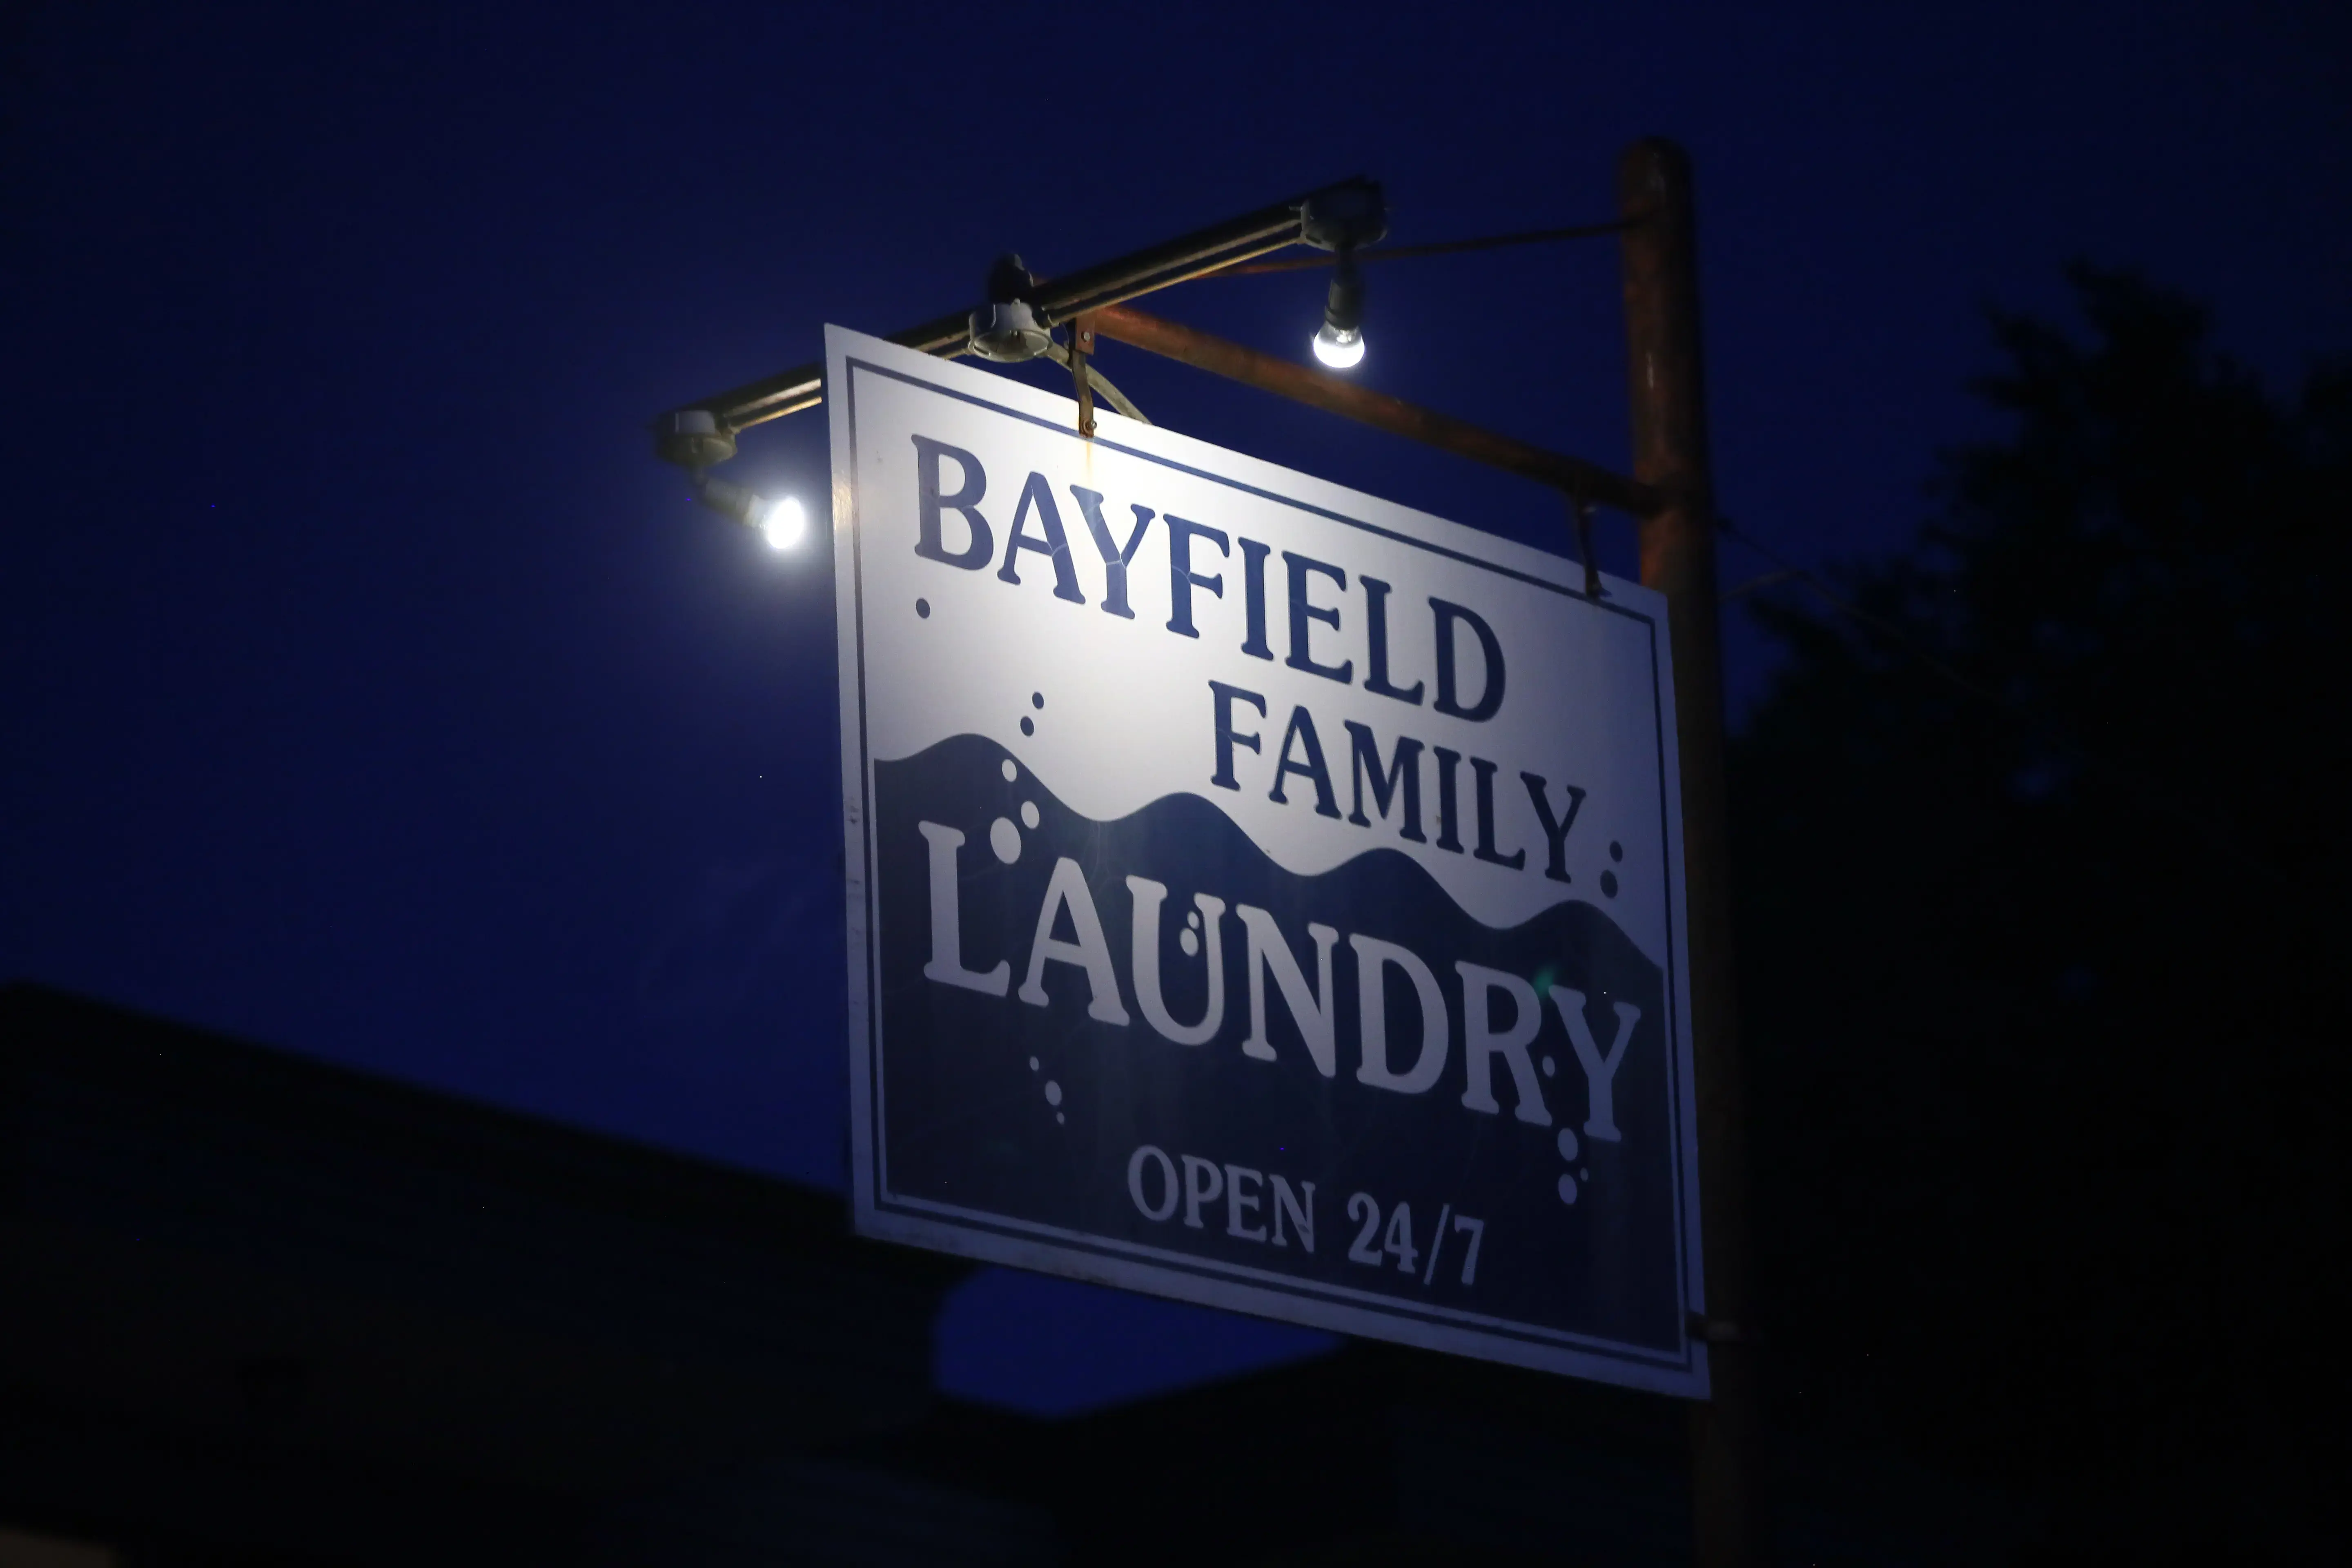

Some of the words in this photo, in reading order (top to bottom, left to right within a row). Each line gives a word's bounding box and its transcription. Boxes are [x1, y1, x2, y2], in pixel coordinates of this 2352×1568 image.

[911, 434, 1506, 724] BAYFIELD
[1209, 680, 1587, 883] FAMILY
[919, 821, 1641, 1143] LAUNDRY
[1127, 1145, 1316, 1253] OPEN
[1347, 1192, 1484, 1285] 24/7
